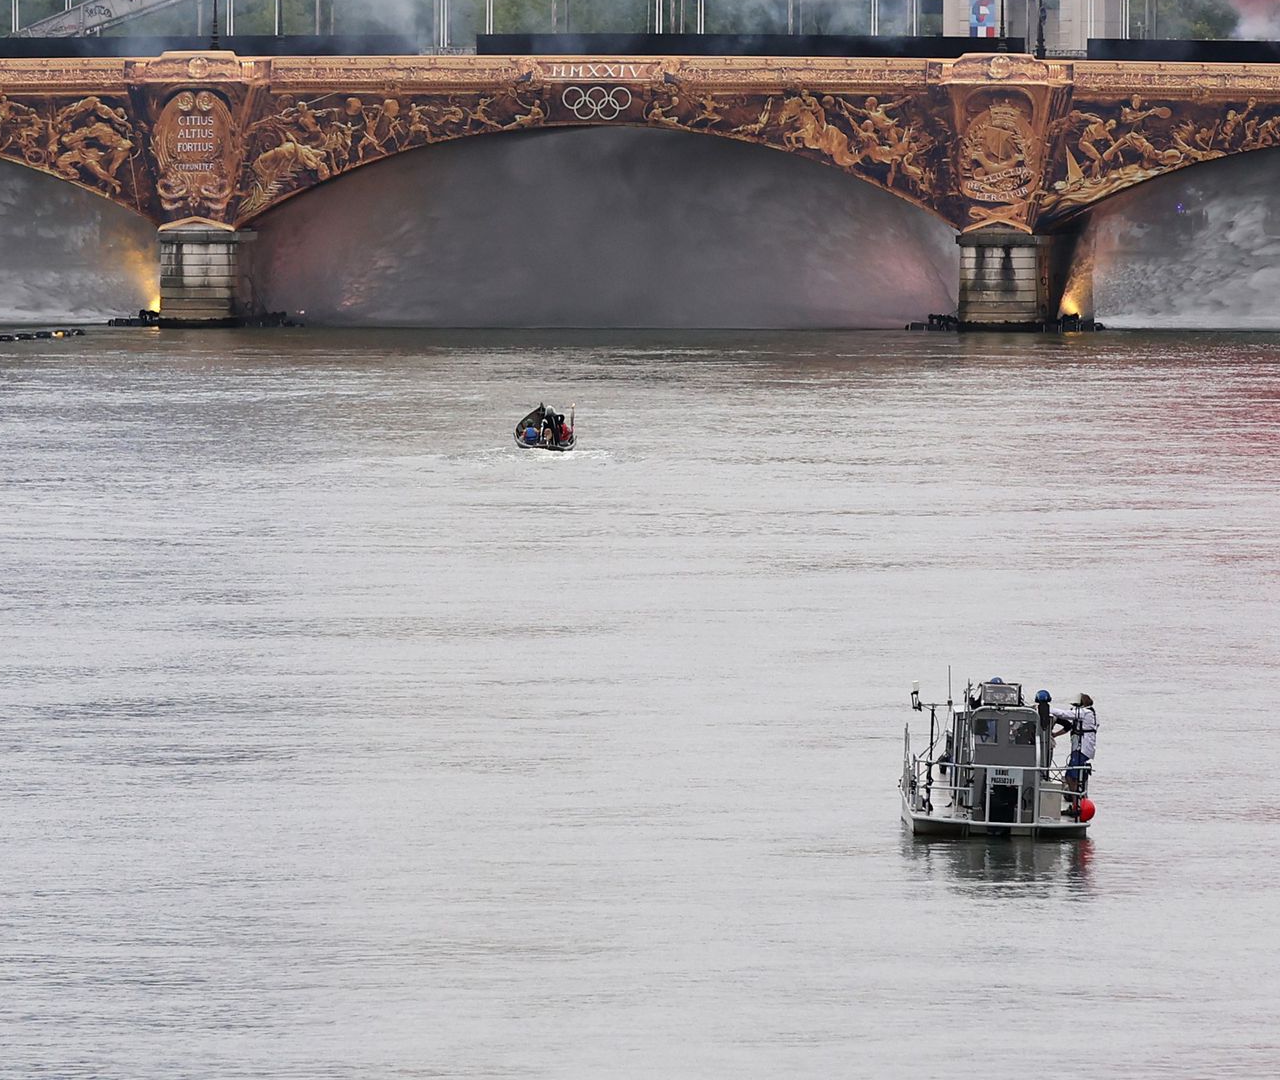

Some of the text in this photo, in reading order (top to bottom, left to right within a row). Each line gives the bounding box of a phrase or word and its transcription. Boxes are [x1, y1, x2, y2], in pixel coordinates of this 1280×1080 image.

[552, 64, 644, 77] MMXXIV
[178, 116, 214, 126] CITIUS
[178, 129, 214, 138] ALTIUS
[177, 142, 214, 152] FORTIUS
